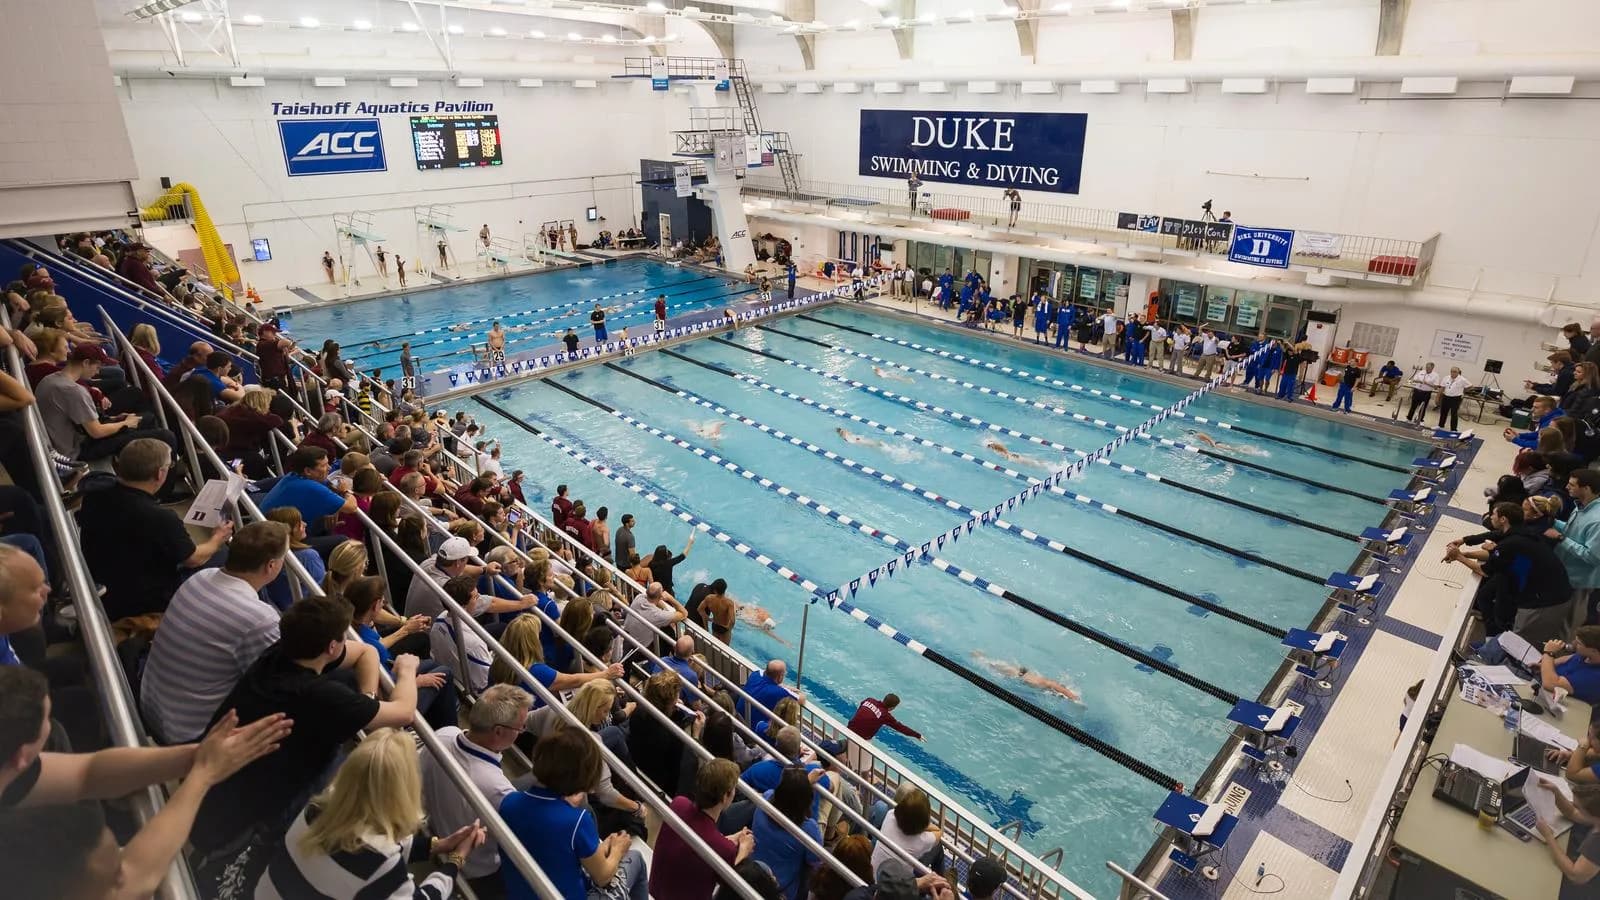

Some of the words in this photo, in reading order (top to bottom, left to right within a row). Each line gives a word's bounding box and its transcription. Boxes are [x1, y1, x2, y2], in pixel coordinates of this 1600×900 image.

[272, 102, 351, 116] Taishoff
[355, 101, 430, 116] Aquatics
[434, 101, 494, 113] Pavilion
[911, 116, 1016, 152] DUKE
[296, 131, 378, 156] ACC
[871, 155, 961, 178] SWIMMING
[966, 163, 980, 179] &
[986, 163, 1060, 186] DIVING
[654, 321, 663, 330] 31
[493, 351, 505, 361] 29
[402, 377, 415, 388] 31
